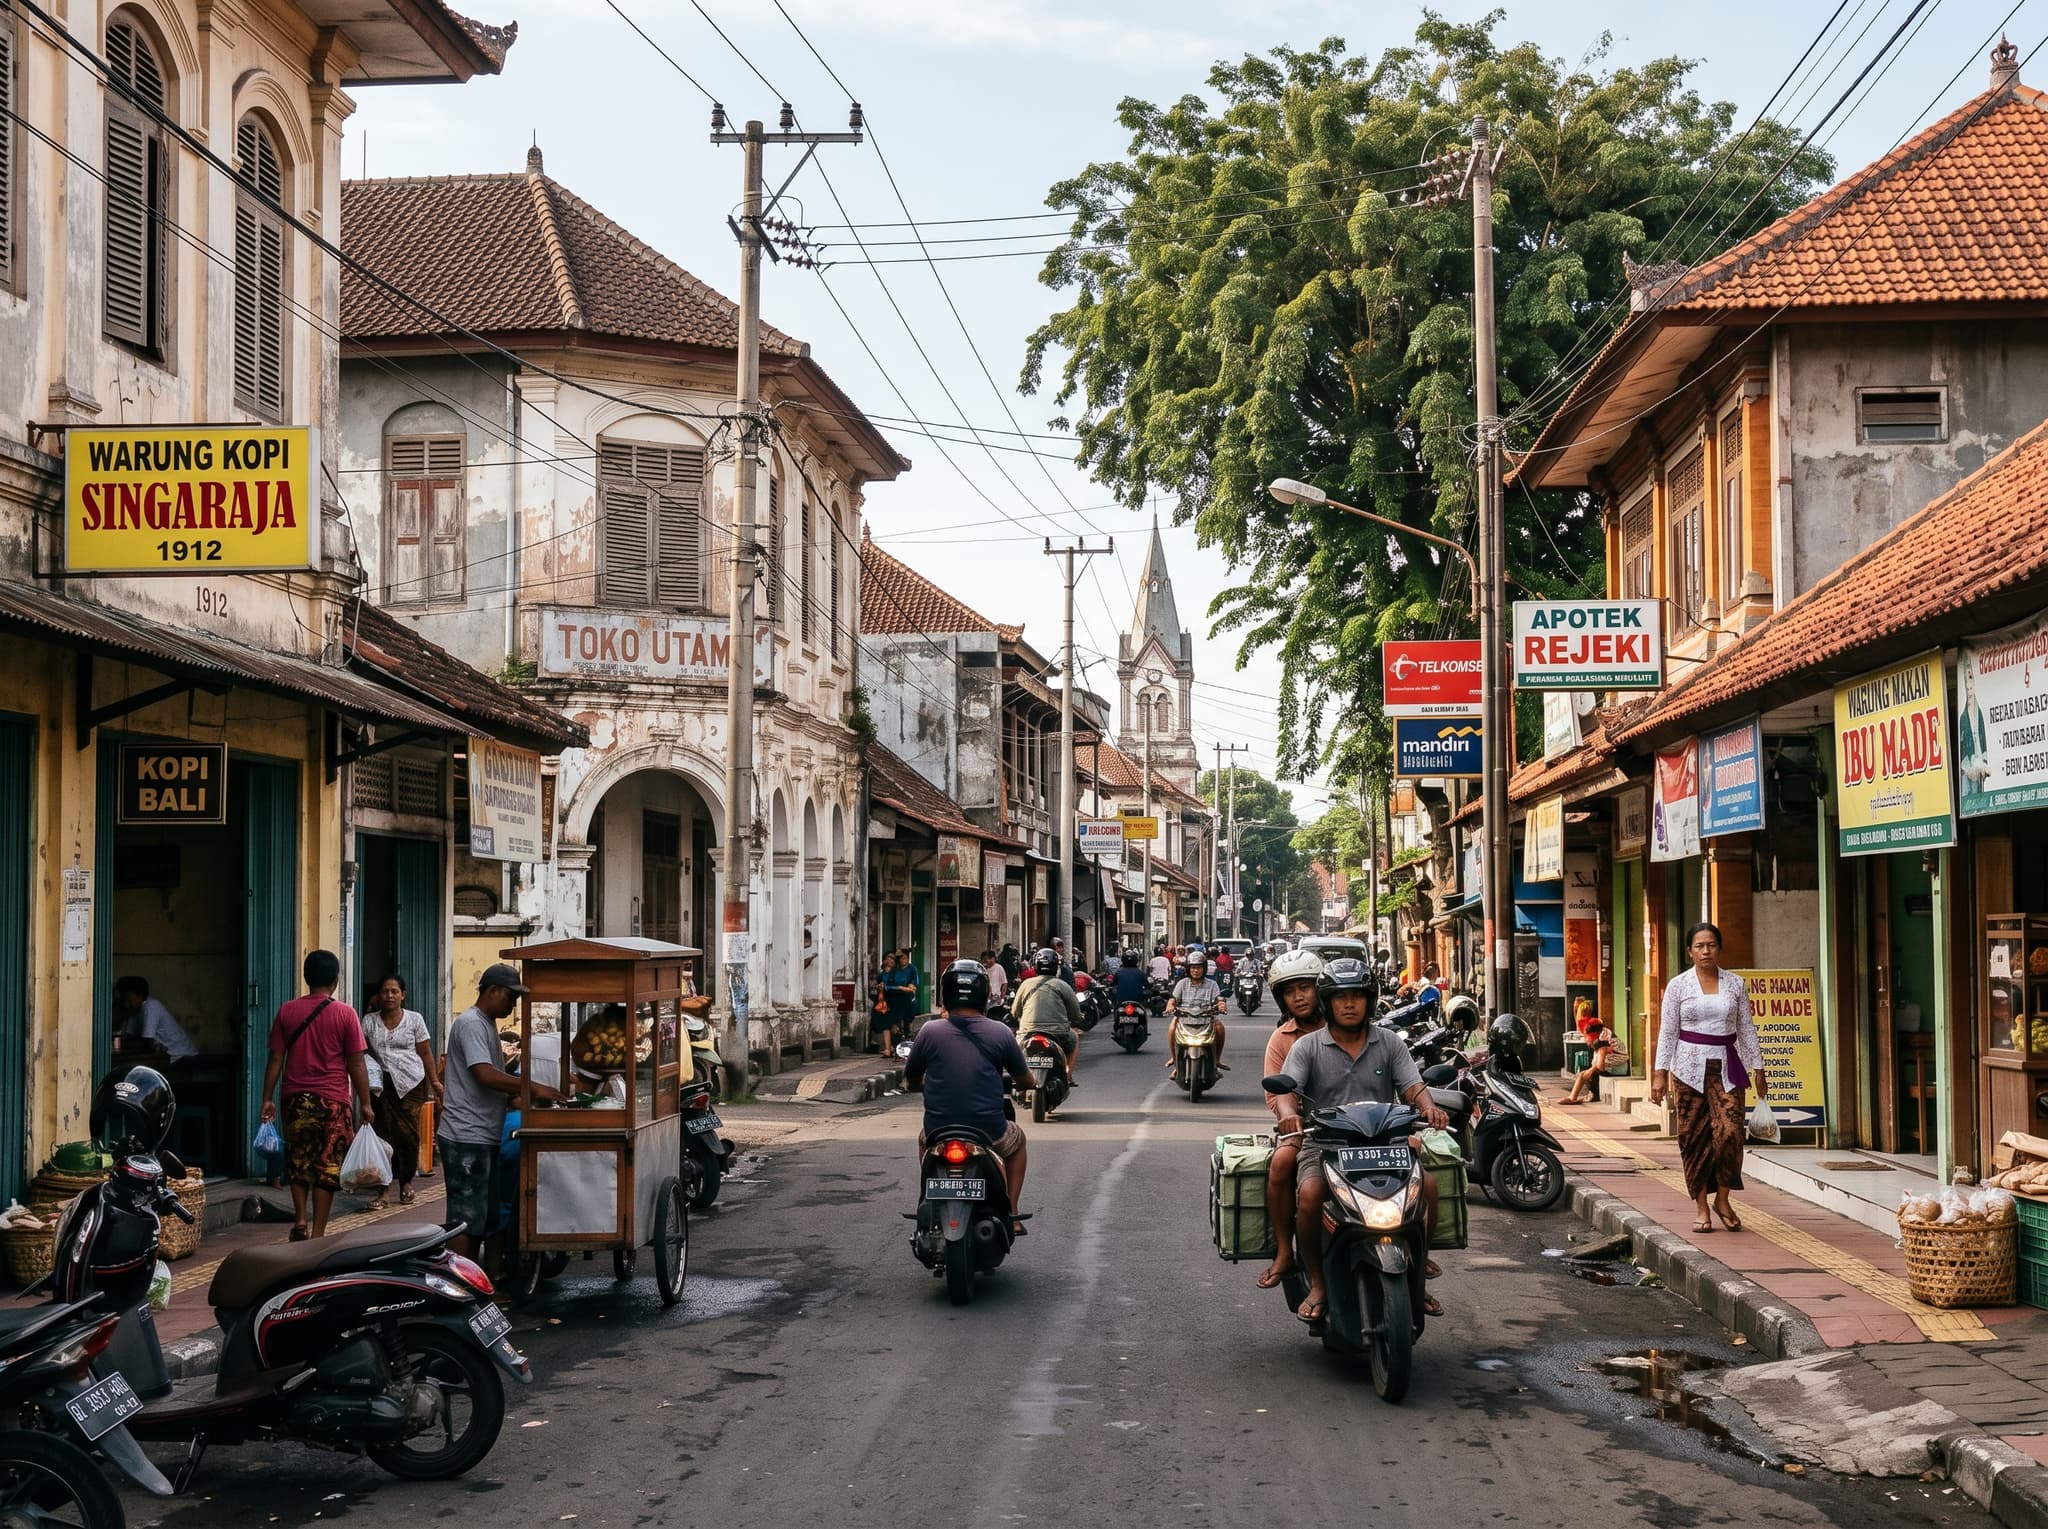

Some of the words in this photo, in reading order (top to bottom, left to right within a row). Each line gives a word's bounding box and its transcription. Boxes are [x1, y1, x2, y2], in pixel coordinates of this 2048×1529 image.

[89, 440, 213, 472] WARUNG
[223, 439, 289, 470] KOPI
[81, 481, 297, 535] SINGARAJA
[157, 540, 222, 561] 1912
[196, 586, 228, 618] 1912
[1530, 607, 1642, 629] APOTEK
[558, 624, 640, 663] TOKO
[652, 630, 731, 667] UTAM
[1525, 634, 1650, 664] REJEKI
[1418, 660, 1483, 673] TELKOMSE
[1847, 680, 1890, 719] WARUNG
[1892, 666, 1930, 706] MAKAN
[1842, 725, 1876, 786] IBU
[1879, 708, 1943, 780] MADE
[137, 756, 209, 780] KOPI
[139, 787, 206, 811] BALI
[1749, 999, 1766, 1017] BU
[1770, 999, 1812, 1017] MADE
